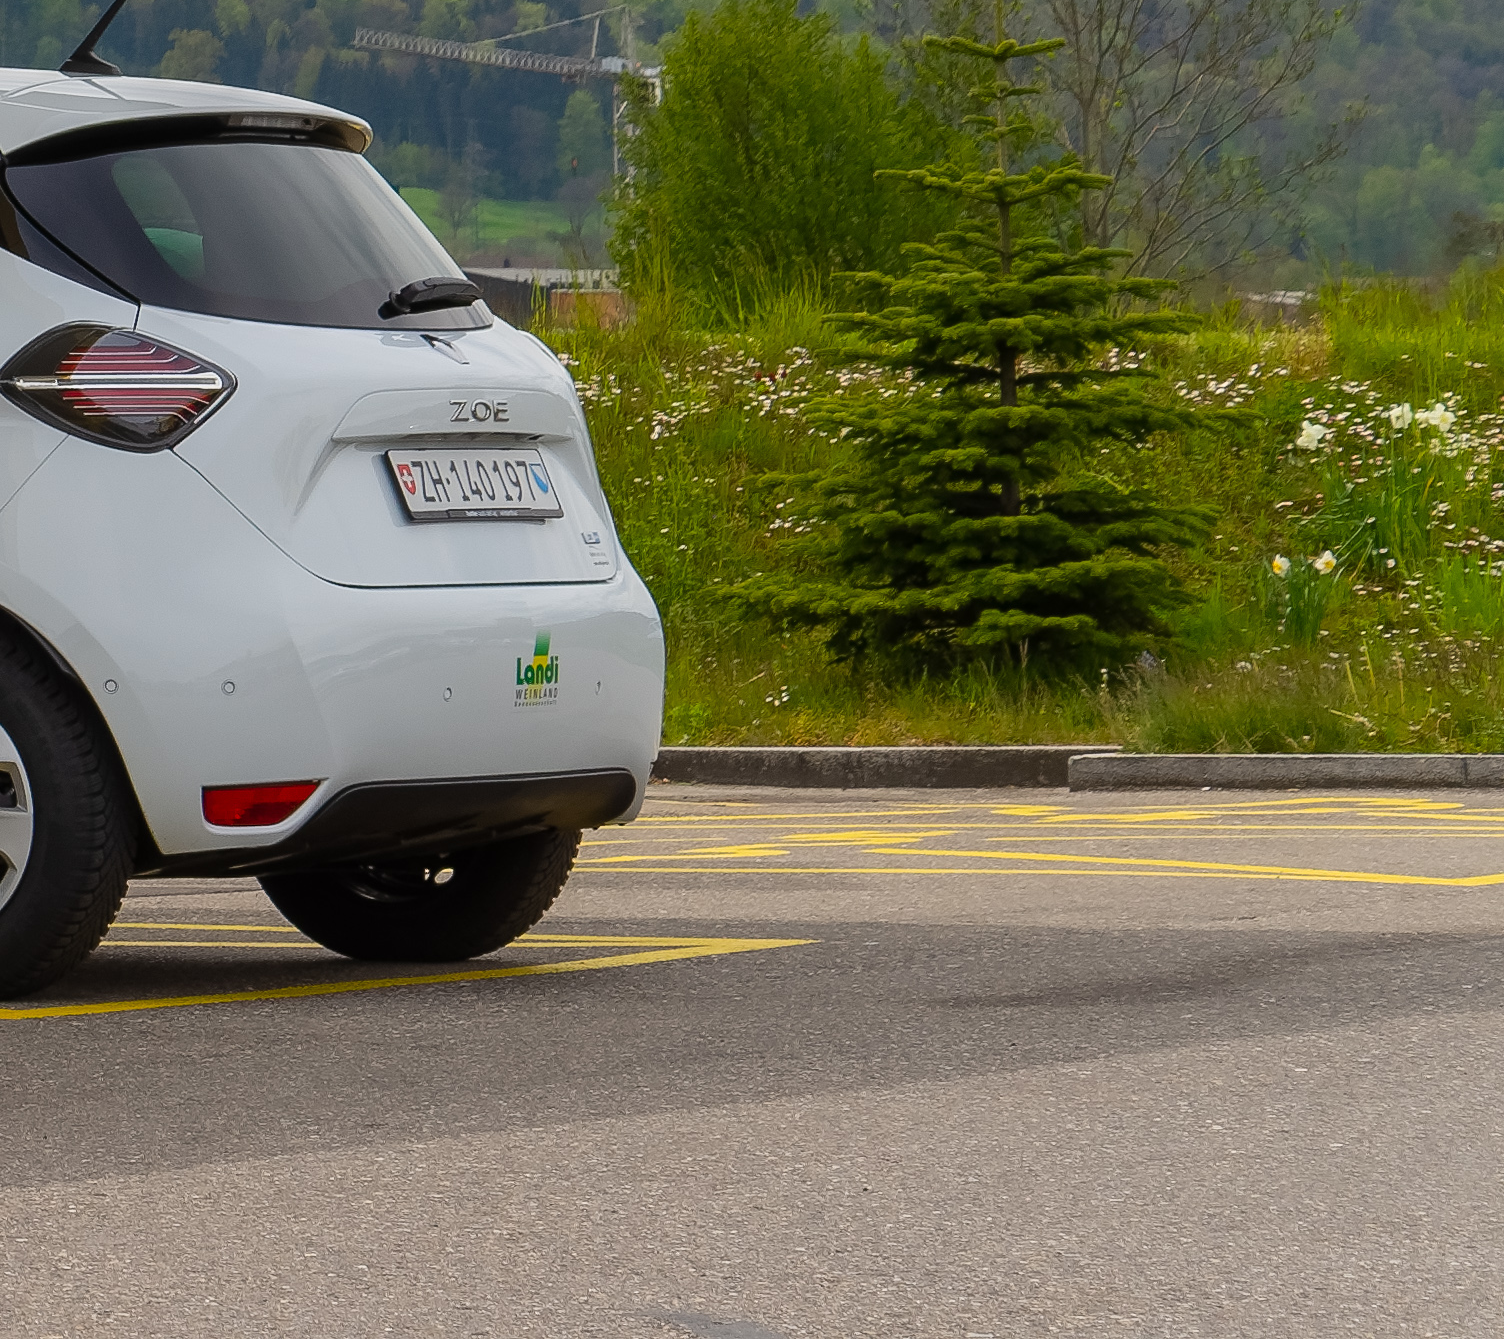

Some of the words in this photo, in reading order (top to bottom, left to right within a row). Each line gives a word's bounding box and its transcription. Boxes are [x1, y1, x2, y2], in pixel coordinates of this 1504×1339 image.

[449, 399, 510, 422] ZOE
[516, 655, 559, 686] Landi
[515, 687, 559, 700] WEINLAND
